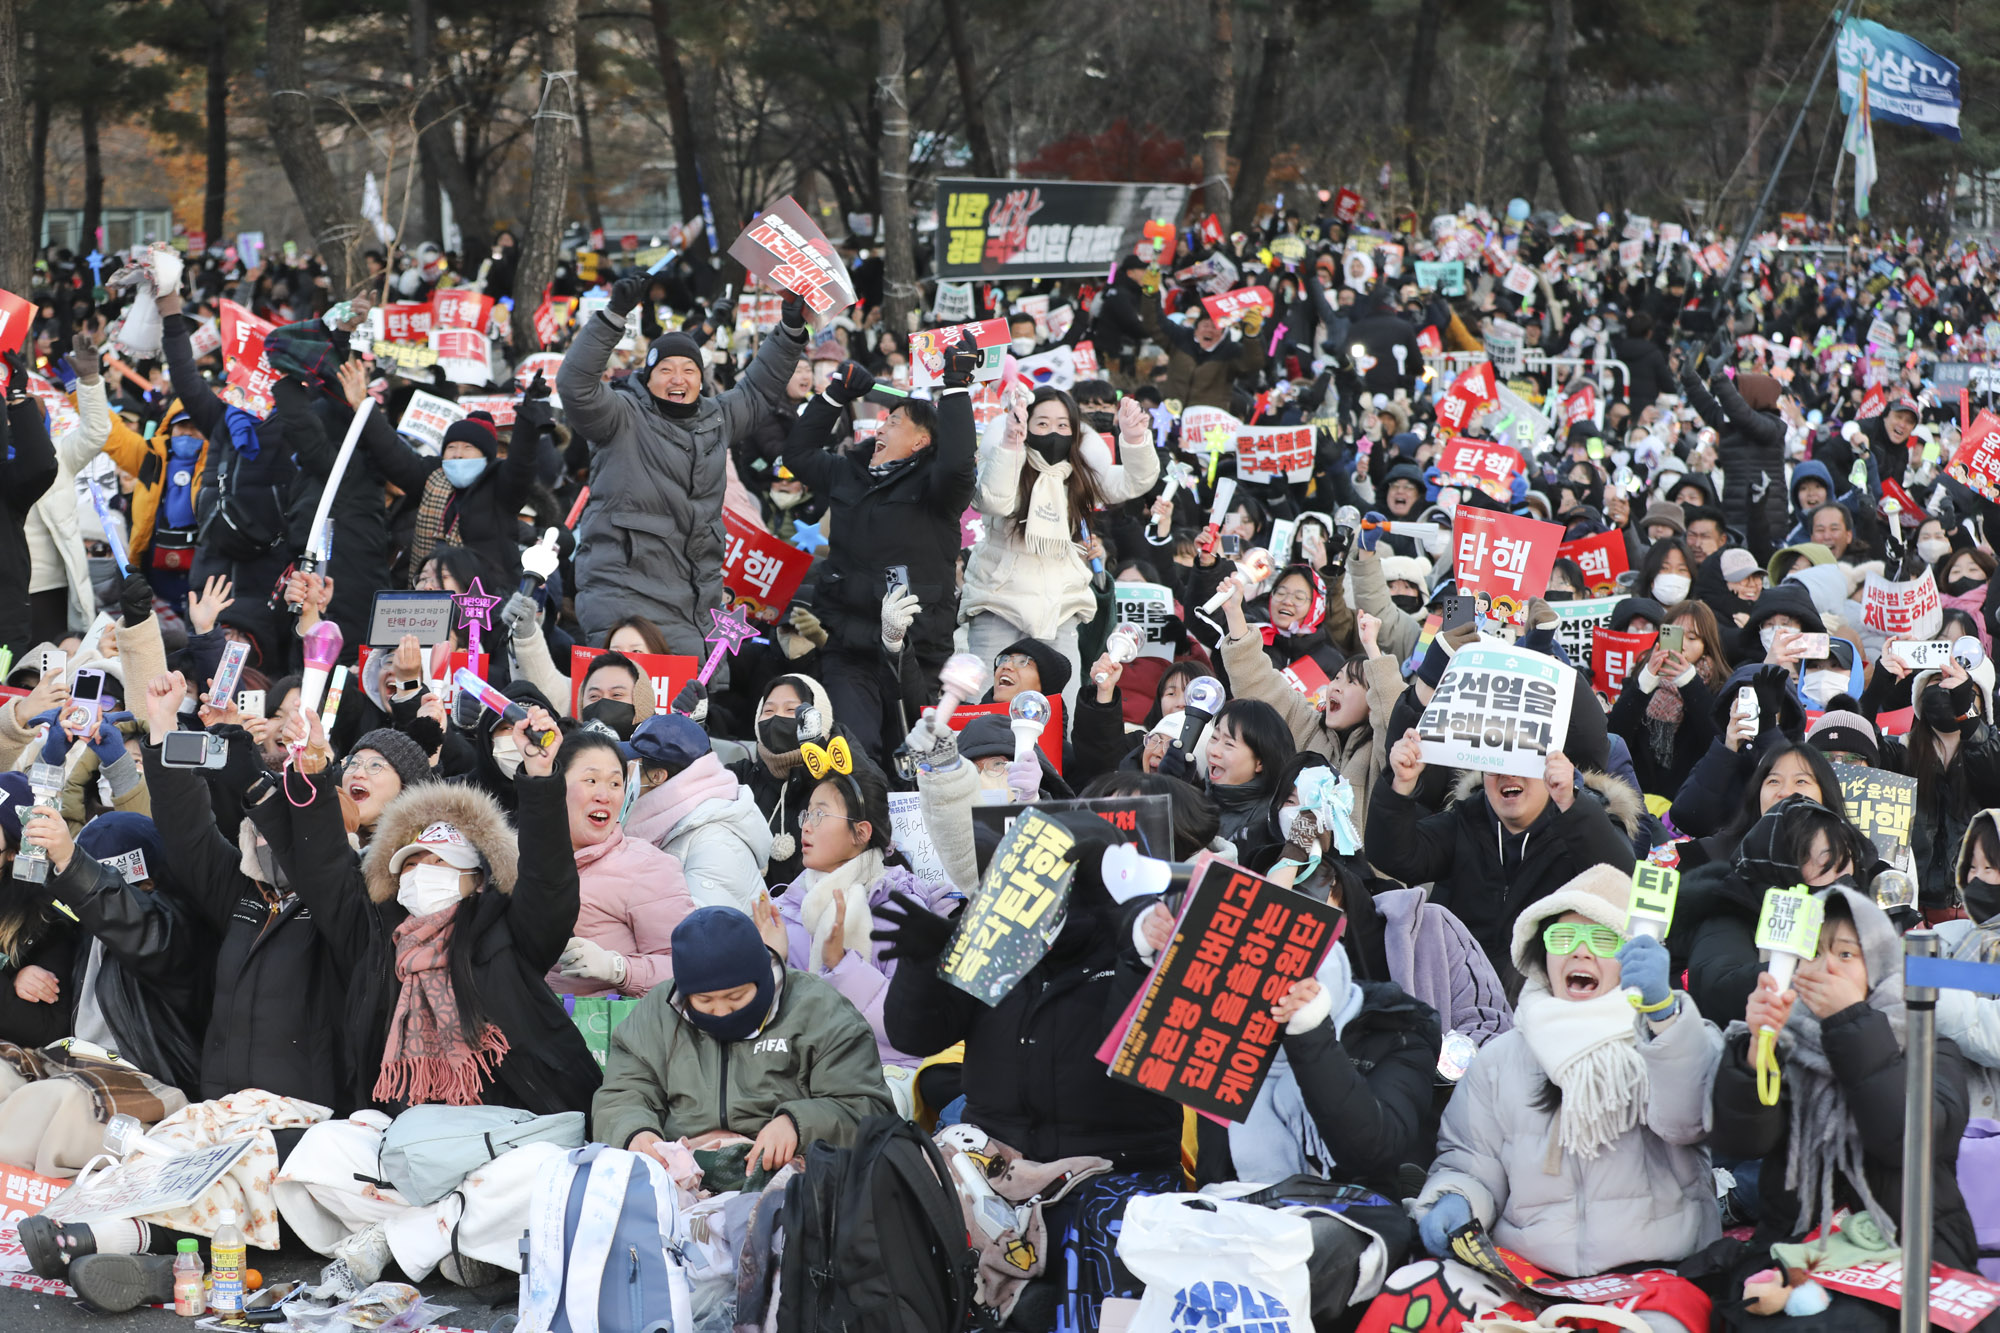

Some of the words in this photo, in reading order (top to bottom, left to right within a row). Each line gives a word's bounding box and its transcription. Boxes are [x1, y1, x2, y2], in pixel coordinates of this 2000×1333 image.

[747, 223, 834, 289] 사건에서
[768, 263, 836, 315] 손떼라
[1215, 289, 1263, 313] 탄핵
[388, 313, 432, 338] 탄핵
[439, 298, 482, 328] 탄핵
[1443, 396, 1467, 428] 핵
[1237, 428, 1312, 455] 윤석열을
[1240, 449, 1315, 475] 구속하라
[1453, 446, 1515, 482] 탄핵
[1457, 531, 1533, 592] 탄핵
[1568, 547, 1612, 580] 핵
[459, 597, 491, 608] 내란의힘
[1867, 585, 1900, 607] 내란범
[1902, 575, 1935, 606] 윤석열
[387, 617, 406, 628] 탄핵
[408, 617, 439, 628] D-day
[717, 613, 751, 636] 내란수괴
[1863, 590, 1939, 634] 체포하라
[1430, 671, 1557, 719] 윤석열을
[1418, 708, 1553, 757] 탄핵하라
[1866, 782, 1912, 805] 윤석열
[943, 892, 994, 975] 내란수괴
[1000, 815, 1046, 874] 윤석열
[1635, 867, 1674, 914] 탄
[1768, 917, 1797, 932] OUT
[1137, 996, 1202, 1092] 올콘병
[1181, 872, 1263, 997] 못버리고
[1179, 1027, 1231, 1091] 집회
[1210, 902, 1292, 1027] 올출하는
[1214, 1009, 1279, 1106] 케이팝
[1261, 911, 1327, 1006] 응원단
[753, 1038, 789, 1056] FIFA
